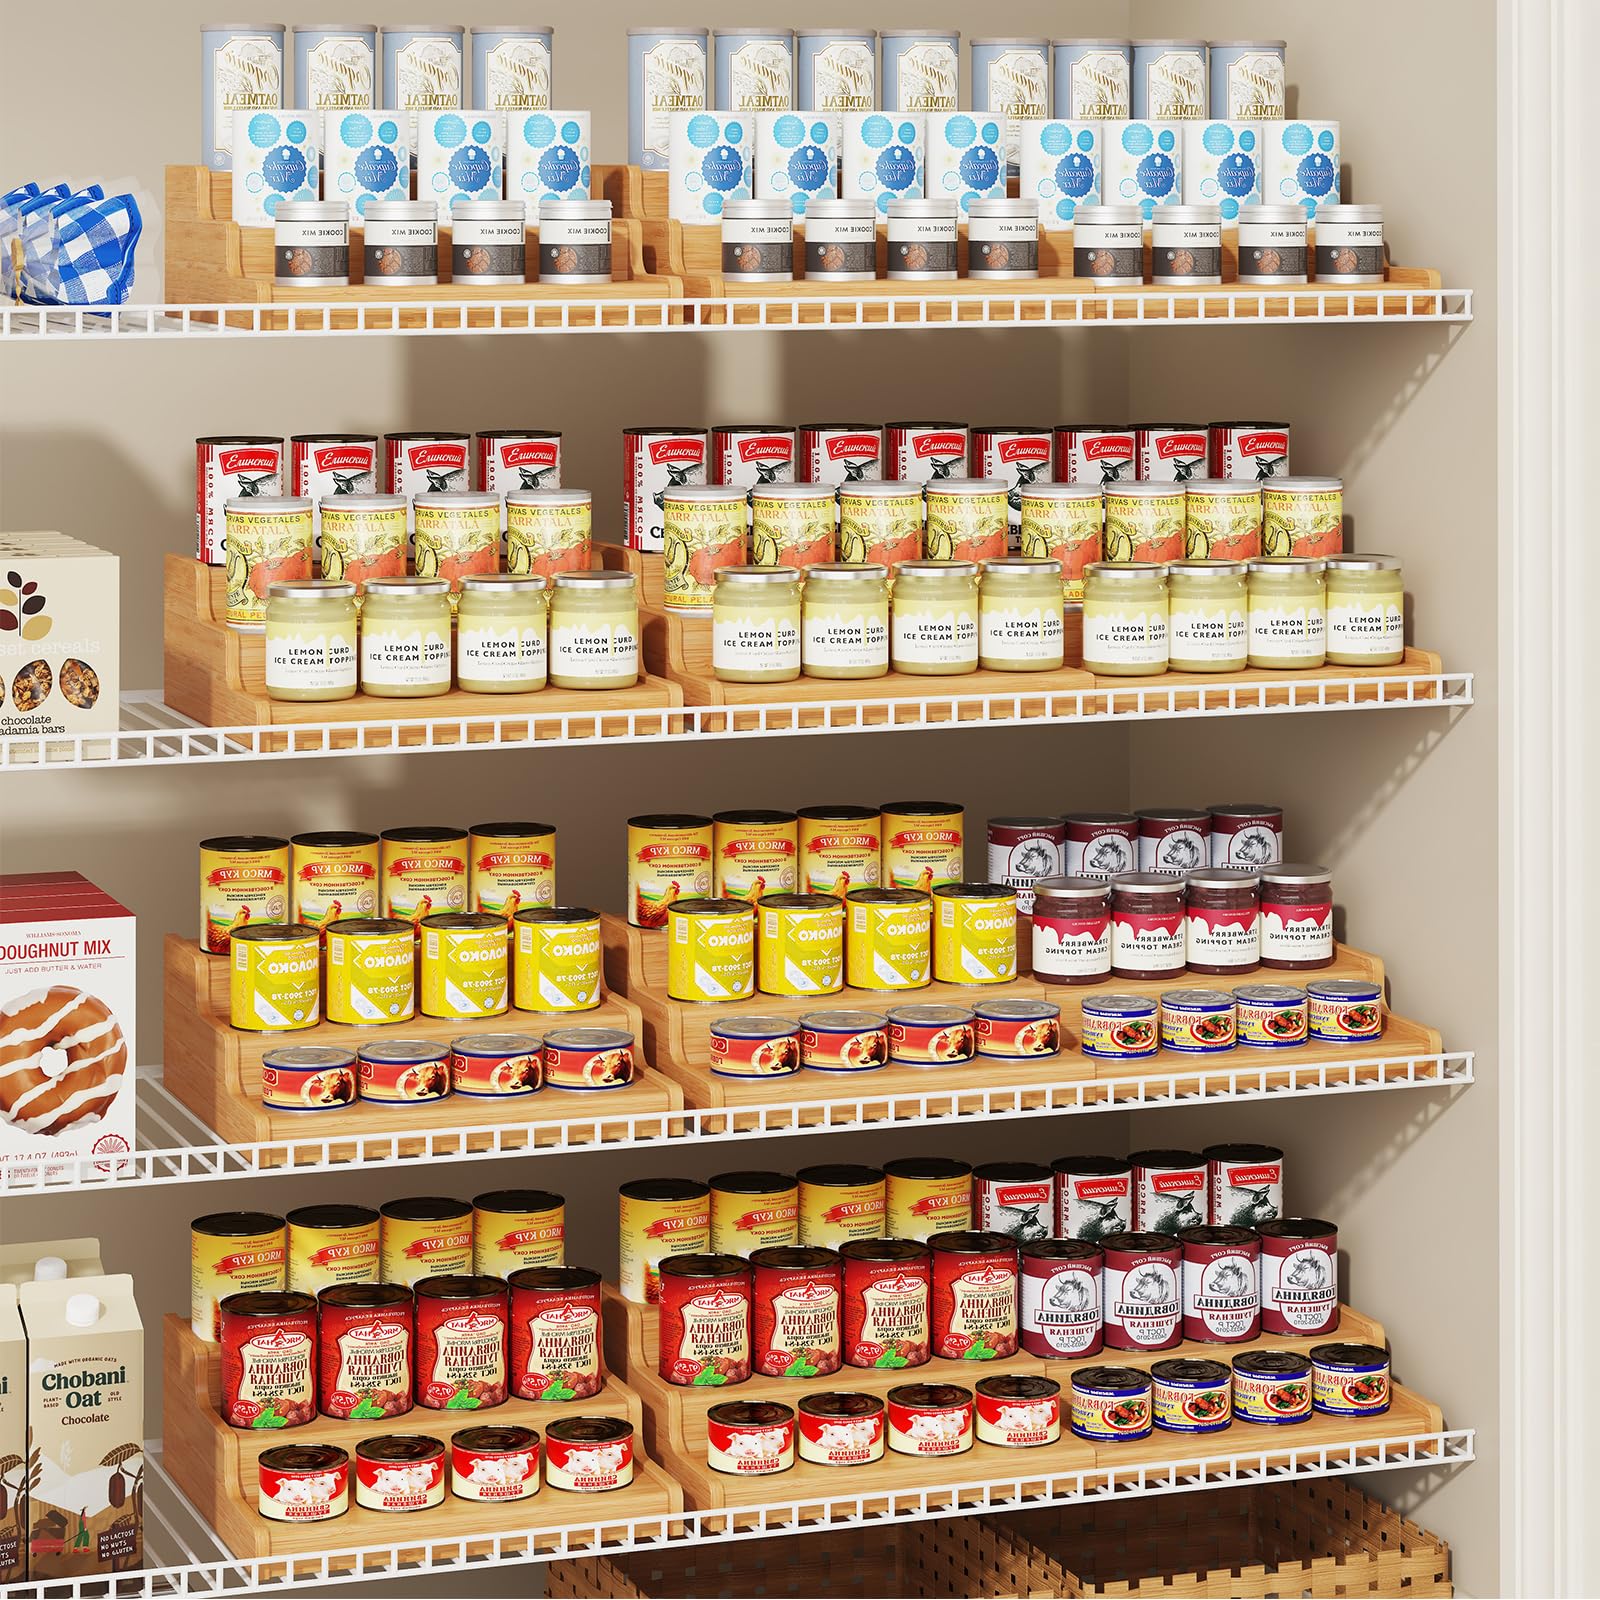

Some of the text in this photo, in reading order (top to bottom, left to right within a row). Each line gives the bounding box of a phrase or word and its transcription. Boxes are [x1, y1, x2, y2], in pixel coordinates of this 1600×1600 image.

[656, 444, 700, 458] Елинский
[745, 442, 789, 457] Елинский
[833, 440, 876, 454] Елинский
[920, 438, 962, 452] Елинский
[1005, 443, 1047, 457] Елинский
[1090, 441, 1131, 455] Елинский
[1163, 440, 1203, 453] Елинский
[1245, 438, 1285, 452] Елинский
[227, 454, 275, 469] Елинский
[322, 452, 369, 467] Елинский
[415, 451, 461, 464] Елинский
[508, 448, 553, 462] Елинский
[688, 503, 738, 511] VEGETALES
[248, 515, 301, 523] VEGETALES
[289, 648, 323, 656] LEMON
[274, 657, 324, 666] ICE CREAM
[1, 715, 52, 725] chocolate
[42, 724, 65, 734] bars
[84, 940, 111, 955] MIX
[41, 964, 69, 972] BUTTER
[42, 1366, 126, 1391] Chobani
[65, 1391, 102, 1408] Oat
[61, 1413, 110, 1426] Chocolate
[110, 1529, 134, 1540] LACTOSE
[111, 1540, 127, 1548] NUTS
[112, 1546, 133, 1556] GLUTEN
